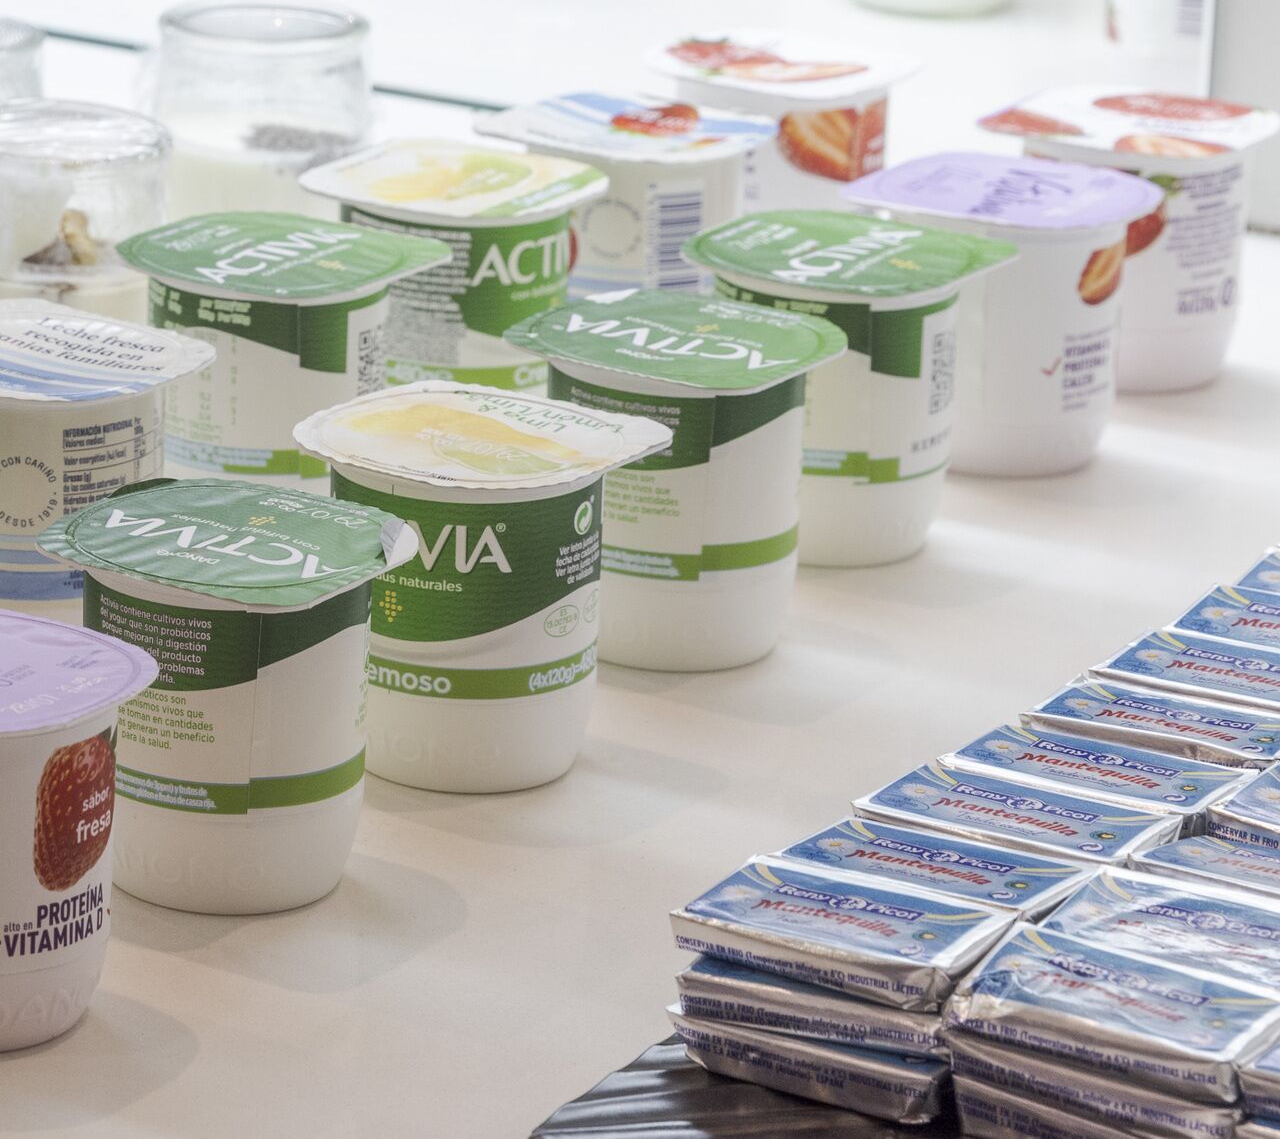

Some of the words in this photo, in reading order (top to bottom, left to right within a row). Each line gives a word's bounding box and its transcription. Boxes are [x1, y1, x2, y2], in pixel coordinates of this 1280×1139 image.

[195, 227, 362, 283] ACTIVIA
[23, 329, 114, 359] recogida
[117, 349, 144, 362] en
[38, 318, 98, 342] Leche
[102, 334, 165, 353] fresca
[566, 313, 798, 370] ACTIVIA
[57, 350, 165, 373] familiares
[1, 456, 21, 468] CON
[25, 457, 56, 483] CARIÑO
[105, 509, 358, 578] ACTIVIA
[293, 539, 320, 551] con
[399, 574, 463, 593] naturales
[100, 594, 119, 610] Activia
[120, 605, 151, 620] contiene
[153, 613, 186, 626] cultivos
[188, 618, 212, 629] vivos
[100, 607, 109, 617] del
[109, 611, 128, 625] yogur
[129, 619, 143, 630] que
[145, 623, 159, 633] son
[161, 627, 211, 641] probióticos
[102, 620, 123, 635] porque
[124, 628, 154, 644] mejoran
[166, 640, 207, 652] digestión
[146, 647, 160, 658] del
[162, 651, 202, 663] producto
[159, 662, 205, 676] problemas
[1188, 648, 1235, 664] Reny
[162, 705, 184, 717] vivos
[187, 710, 204, 720] que
[171, 695, 187, 705] son
[1117, 698, 1164, 715] Reny
[1199, 716, 1252, 730] Picot
[127, 708, 151, 722] toman
[152, 715, 163, 725] en
[165, 717, 214, 732] cantidades
[127, 720, 159, 735] generan
[160, 729, 171, 738] un
[173, 730, 215, 744] beneficio
[1095, 709, 1239, 742] Mantequilla
[122, 730, 138, 742] para
[139, 735, 146, 744] la
[148, 737, 172, 750] salud.
[1015, 752, 1162, 790] Mantequilla
[1039, 740, 1089, 757] Reny
[1124, 760, 1176, 778] Picot
[82, 786, 109, 812] sabor
[957, 785, 1004, 802] Reny
[1043, 805, 1096, 822] Picot
[76, 809, 111, 844] fresa
[931, 797, 1080, 837] Mantequilla
[1208, 822, 1248, 840] CONSERVAR
[1250, 833, 1260, 843] EN
[1262, 836, 1279, 849] FRIO
[845, 849, 992, 886] Mantequilla
[875, 837, 924, 855] Reny
[960, 856, 1011, 873] Picot
[4, 922, 20, 932] alto
[24, 922, 33, 931] en
[37, 882, 103, 928] PROTEÍNA
[751, 899, 900, 937] Mantequilla
[777, 884, 830, 906] Reny
[866, 902, 920, 921] Picot
[4, 918, 94, 957] VITAMINA
[96, 907, 103, 931] D
[676, 935, 714, 950] CONSERVAR
[717, 944, 726, 953] EN
[727, 947, 744, 958] FRIO
[847, 973, 889, 991] INDUSTRIAS
[891, 980, 924, 996] LÁCTEAS
[674, 1022, 710, 1041] CONSERVAR
[713, 1035, 722, 1044] EN
[680, 994, 721, 1008] CONSERVAR
[725, 1001, 735, 1011] EN
[737, 1003, 754, 1015] FRIO
[869, 1026, 914, 1042] INDUSTRIAS
